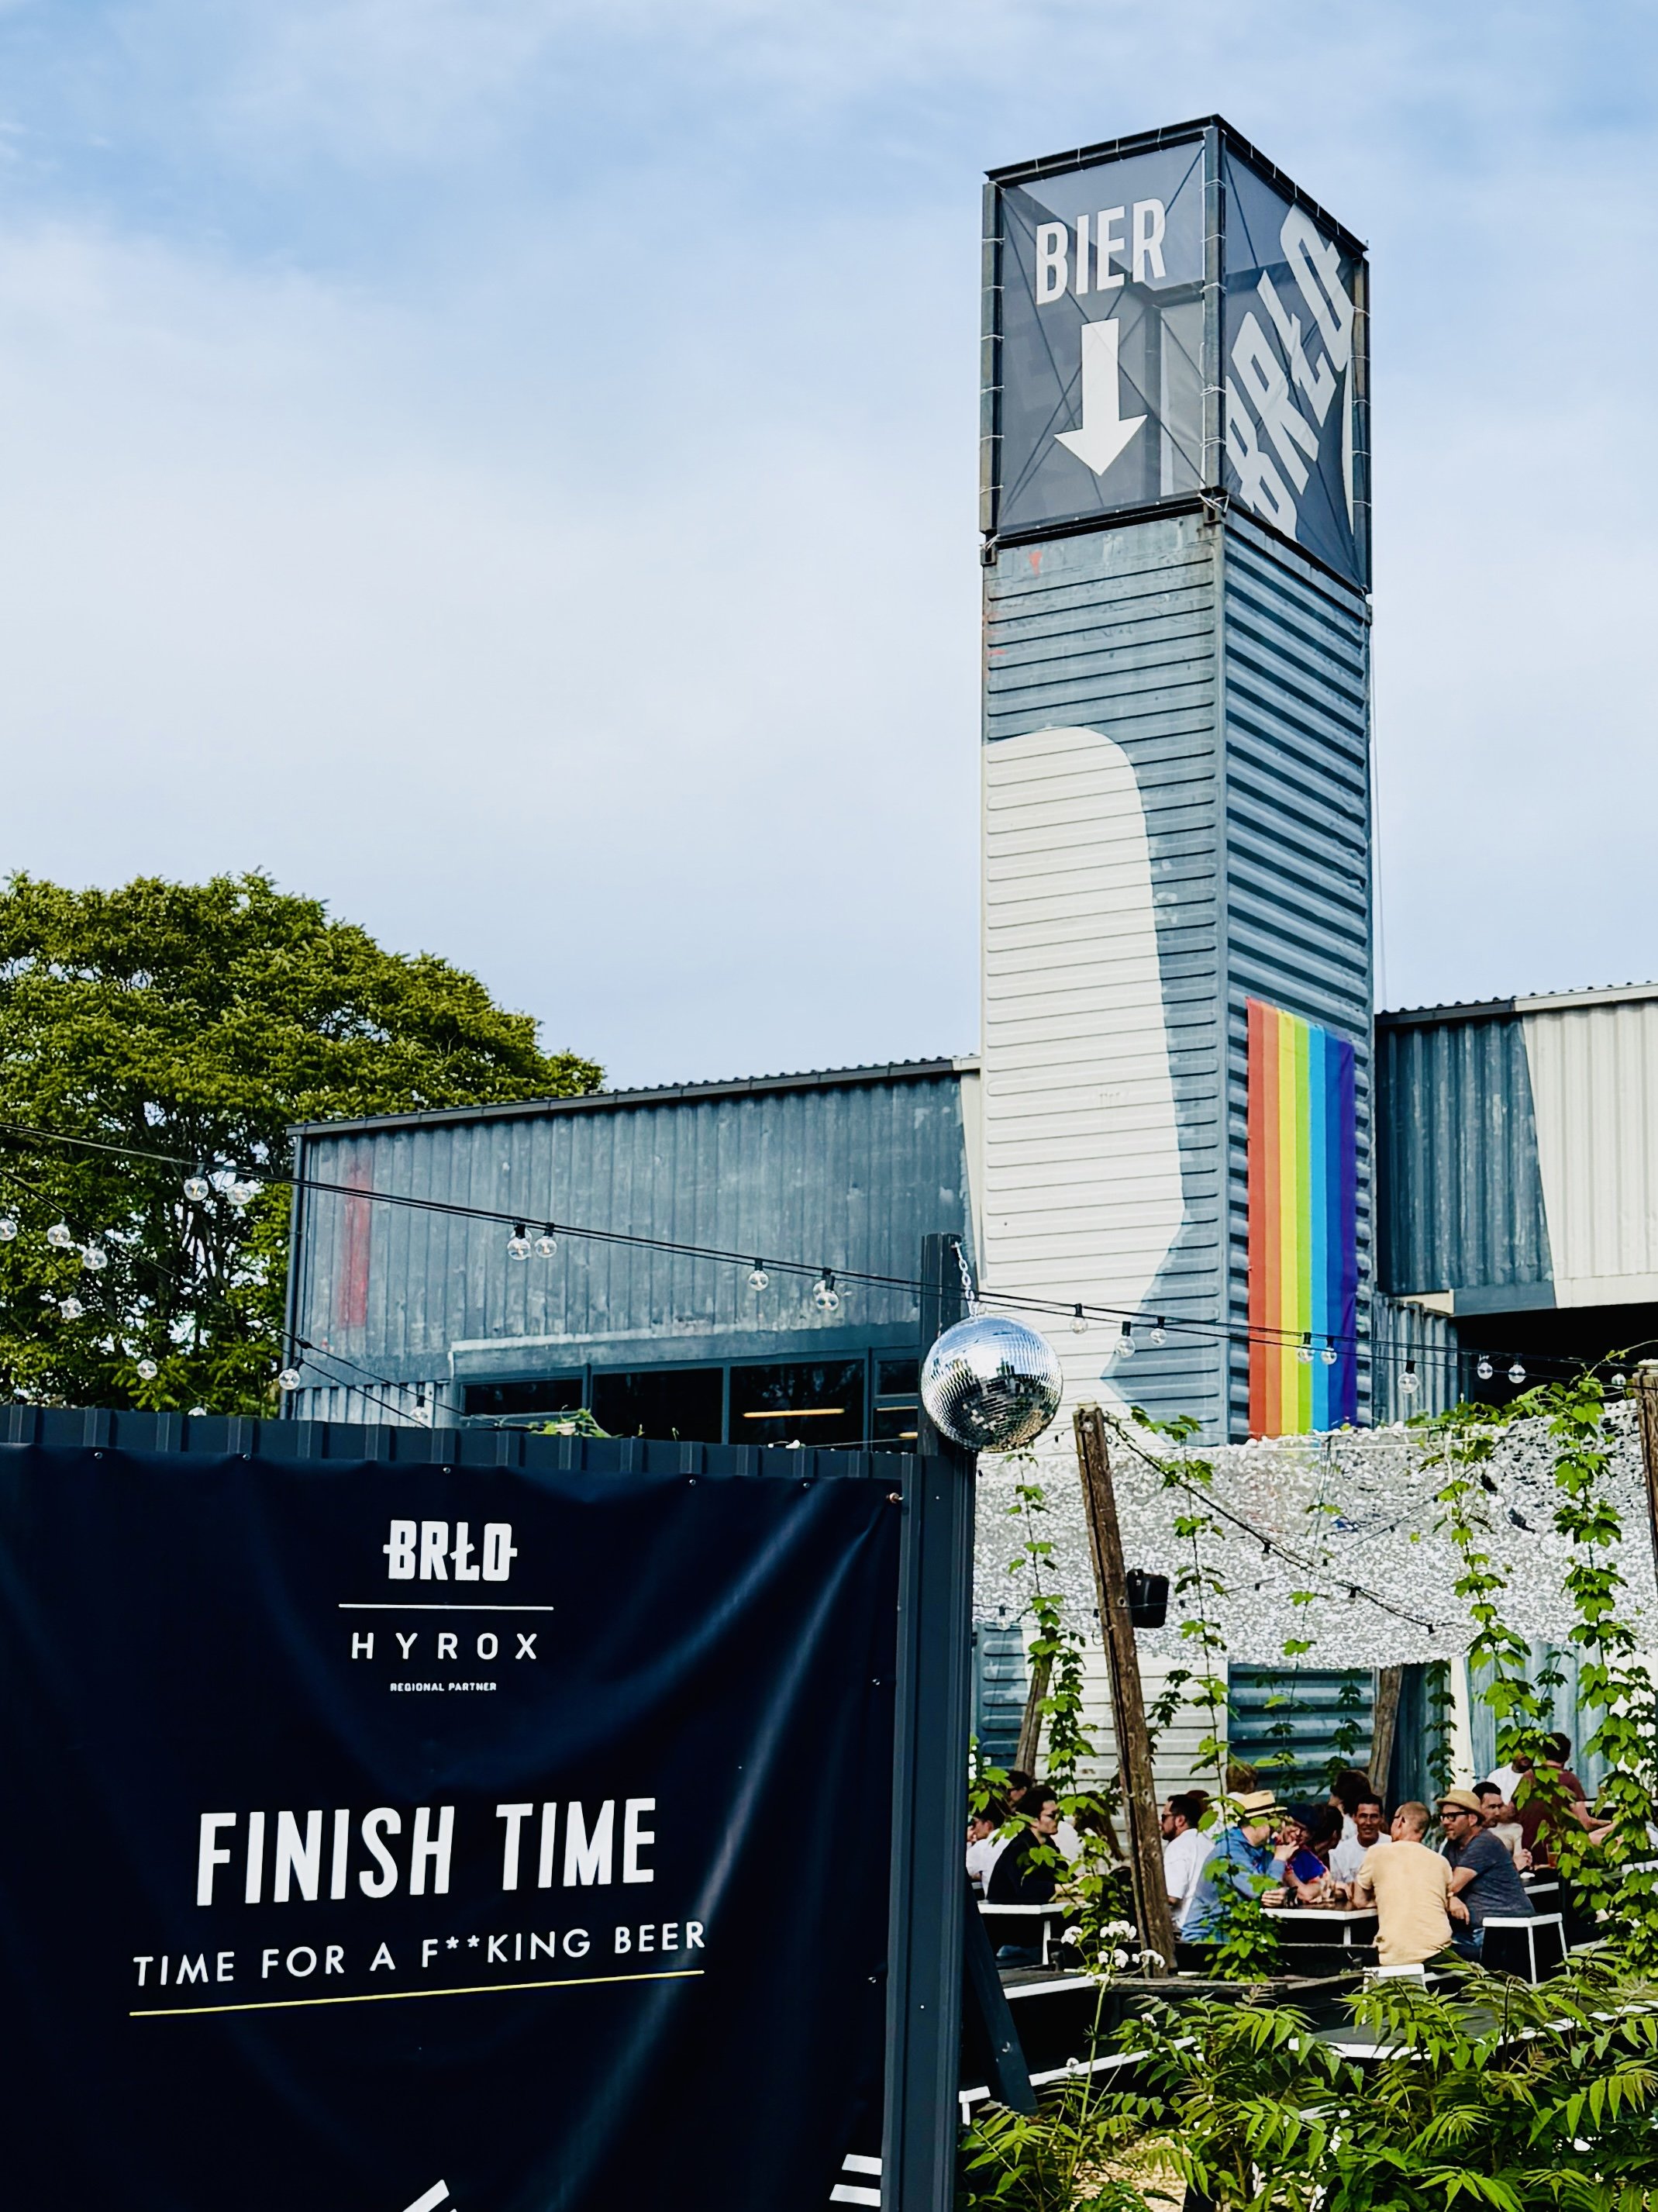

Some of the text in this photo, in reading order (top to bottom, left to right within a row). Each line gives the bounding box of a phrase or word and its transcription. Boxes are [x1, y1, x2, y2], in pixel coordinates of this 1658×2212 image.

[1036, 198, 1167, 305] BIER
[382, 1519, 518, 1582] BRŁO
[351, 1632, 537, 1660] HYROX
[390, 1682, 497, 1692] REGIONAL PARTNER
[197, 1797, 656, 1907] FINISH TIME
[133, 1951, 235, 1986] TIME
[261, 1945, 345, 1979] FOR
[369, 1941, 396, 1972] A
[614, 1920, 706, 1954] BEER
